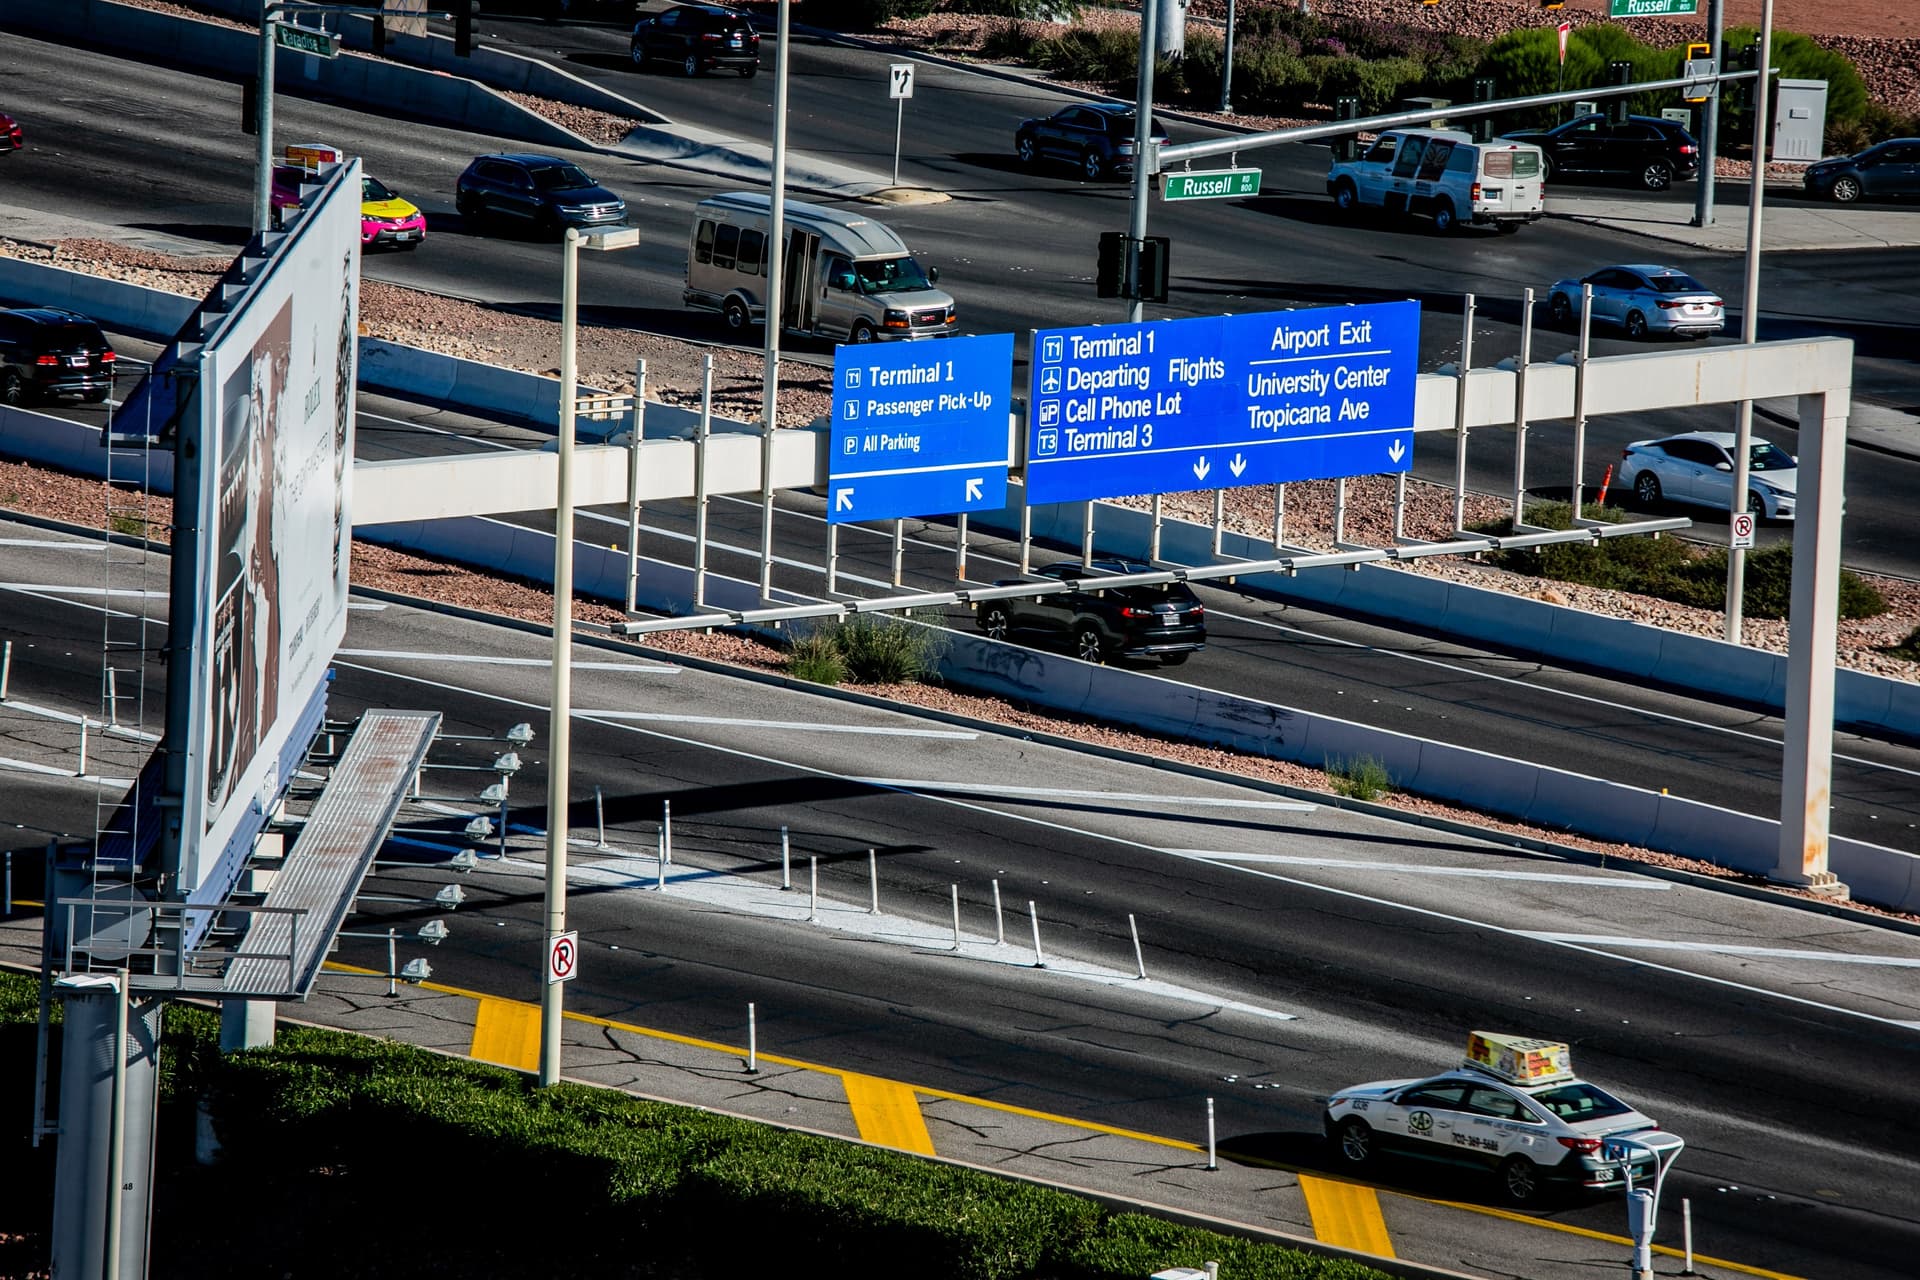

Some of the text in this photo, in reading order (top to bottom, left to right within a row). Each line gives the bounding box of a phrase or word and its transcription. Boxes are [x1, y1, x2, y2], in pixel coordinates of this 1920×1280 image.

[1628, 0, 1672, 13] Russell
[282, 28, 319, 52] Paradise
[1184, 176, 1232, 195] Russell
[1046, 342, 1061, 357] T1
[1070, 330, 1155, 359] Terminal 1
[1271, 320, 1372, 354] Airport Exit
[848, 372, 859, 385] T1
[869, 360, 954, 387] Terminal 1
[1067, 357, 1225, 394] Departing Flights
[1248, 365, 1391, 397] University Center
[867, 391, 992, 417] Passenger Pick-Up
[1065, 391, 1182, 423] Cell Phone Lot
[1248, 398, 1370, 432] Tropicana Ave
[863, 433, 920, 453] All Parking
[1040, 435, 1056, 450] T3
[1065, 423, 1153, 452] Terminal 3
